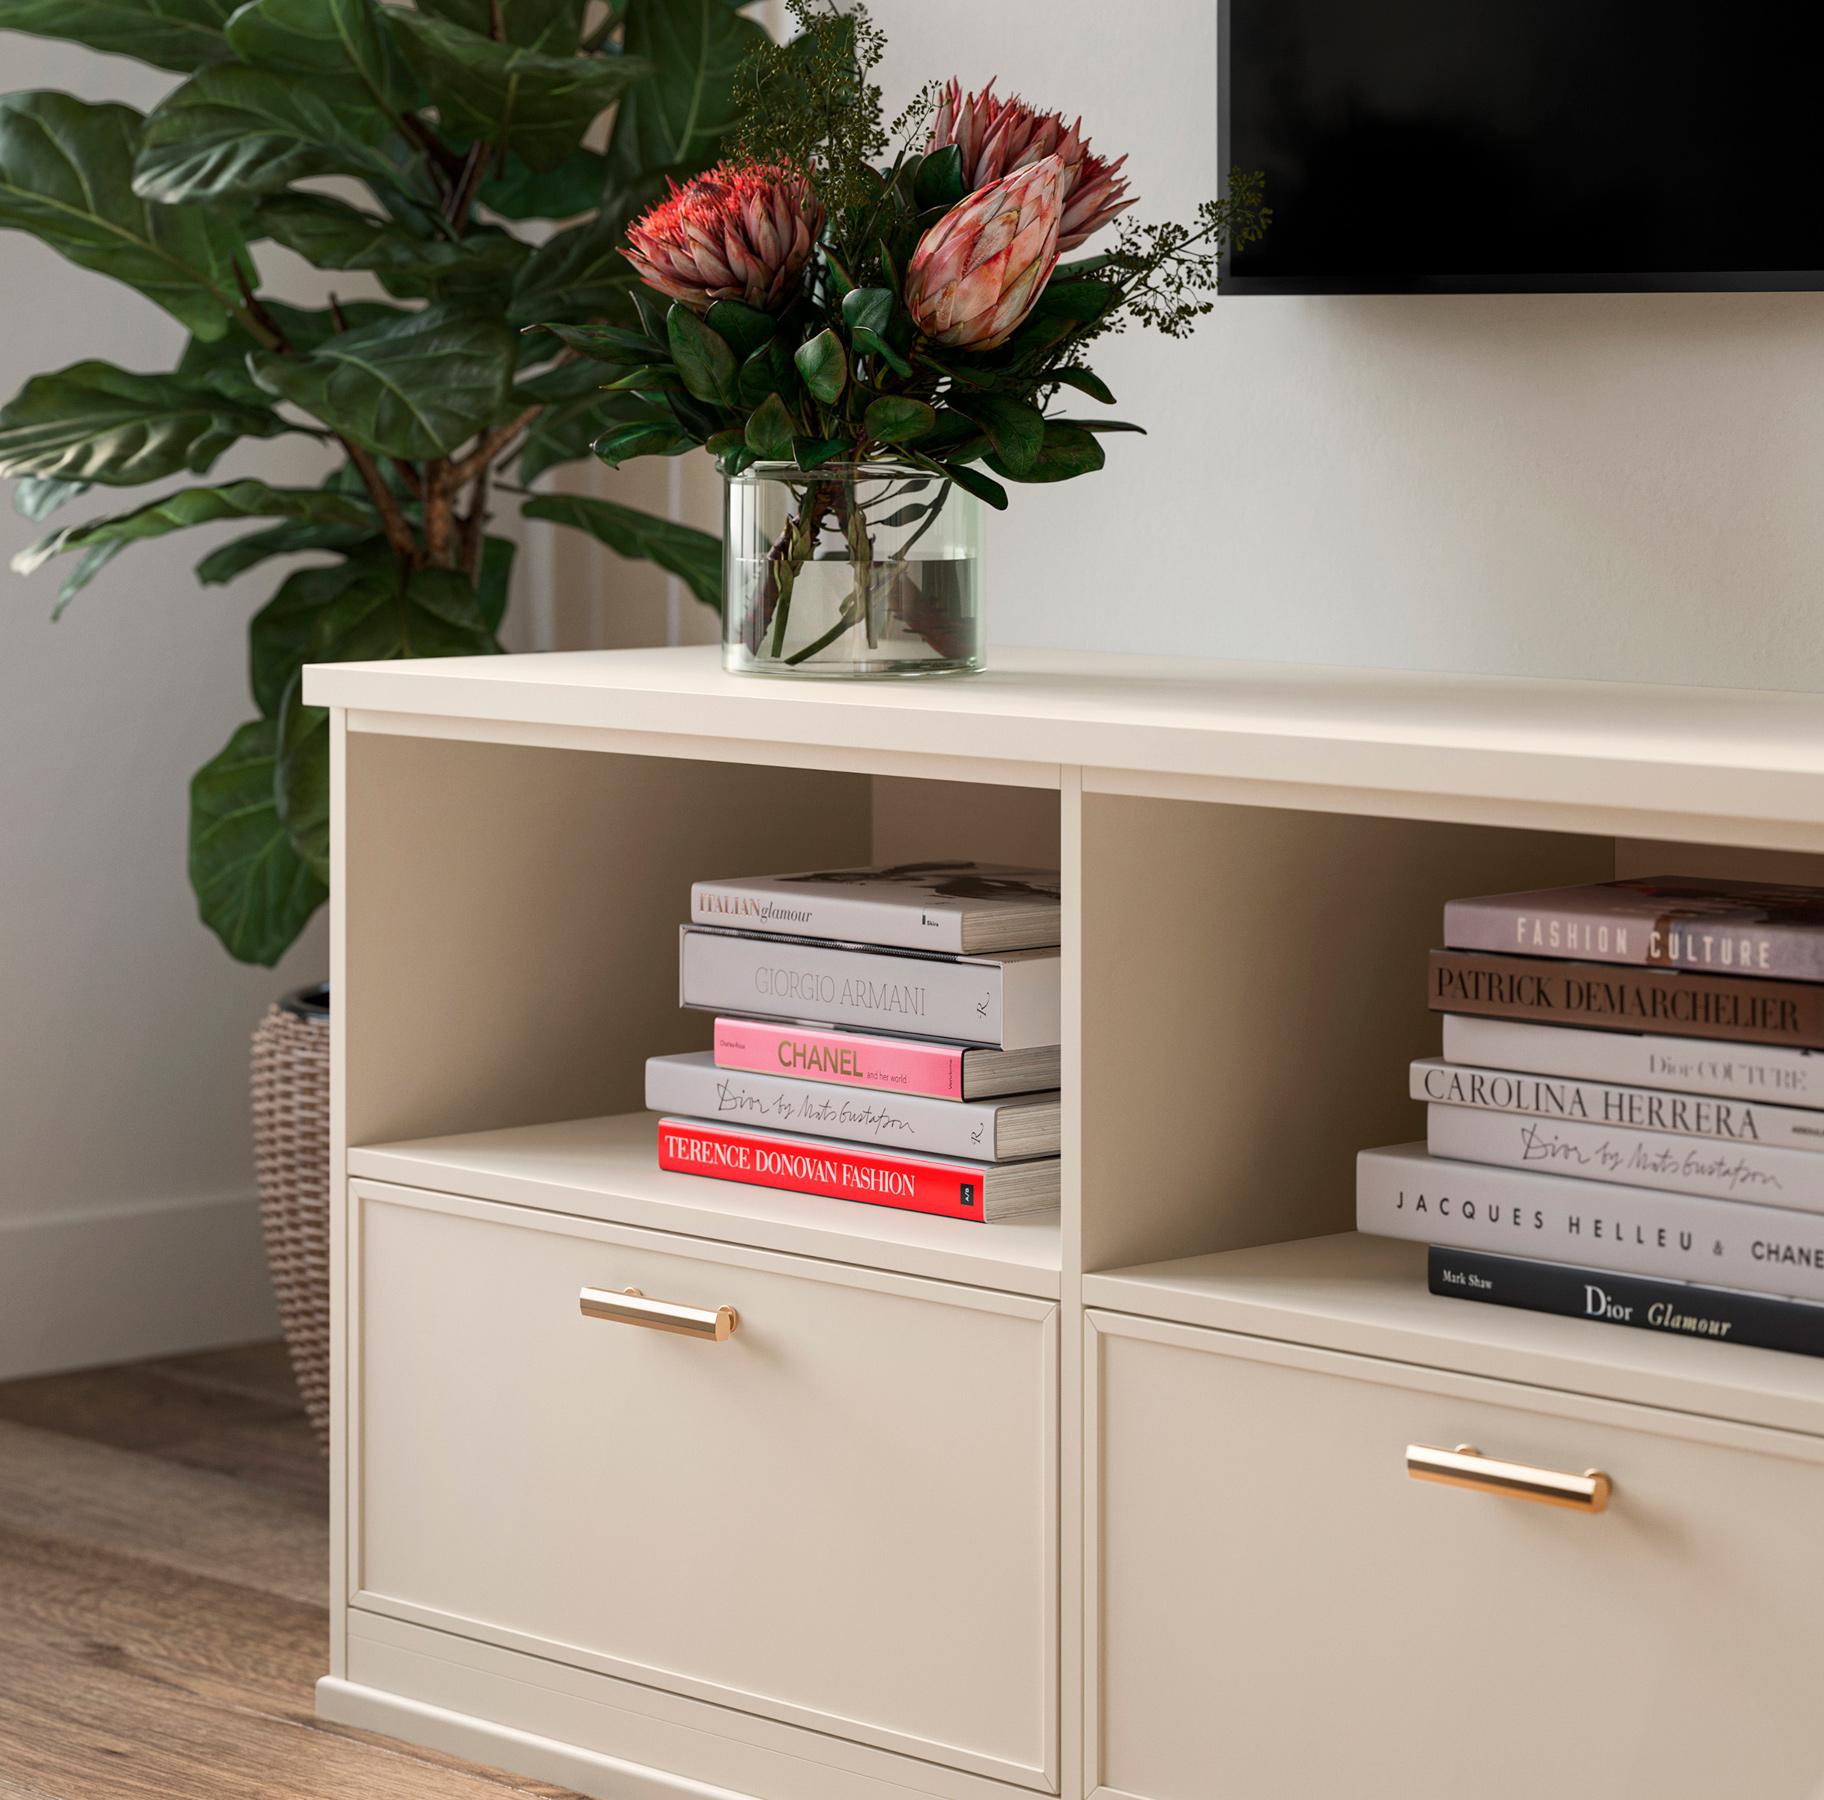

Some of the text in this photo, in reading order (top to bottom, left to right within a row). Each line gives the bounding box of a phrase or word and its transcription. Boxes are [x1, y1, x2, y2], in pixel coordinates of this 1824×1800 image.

[1517, 917, 1771, 968] FASHION CULTURE
[754, 966, 927, 1016] GIORGIO ARMANI
[1436, 967, 1800, 1033] PATRICK DEMARCHELIER
[778, 1040, 863, 1077] CHANEL
[1650, 1054, 1807, 1092] Dior COUTURE
[1424, 1069, 1759, 1140] CAROLINA HERRERA
[665, 1135, 916, 1197] TERENCE DONOVAN FASHION
[1397, 1191, 1824, 1269] JACQUES HELLEU & CHANE
[1442, 1268, 1493, 1290] Mark Shaw
[1585, 1285, 1732, 1338] Dior Glamour
